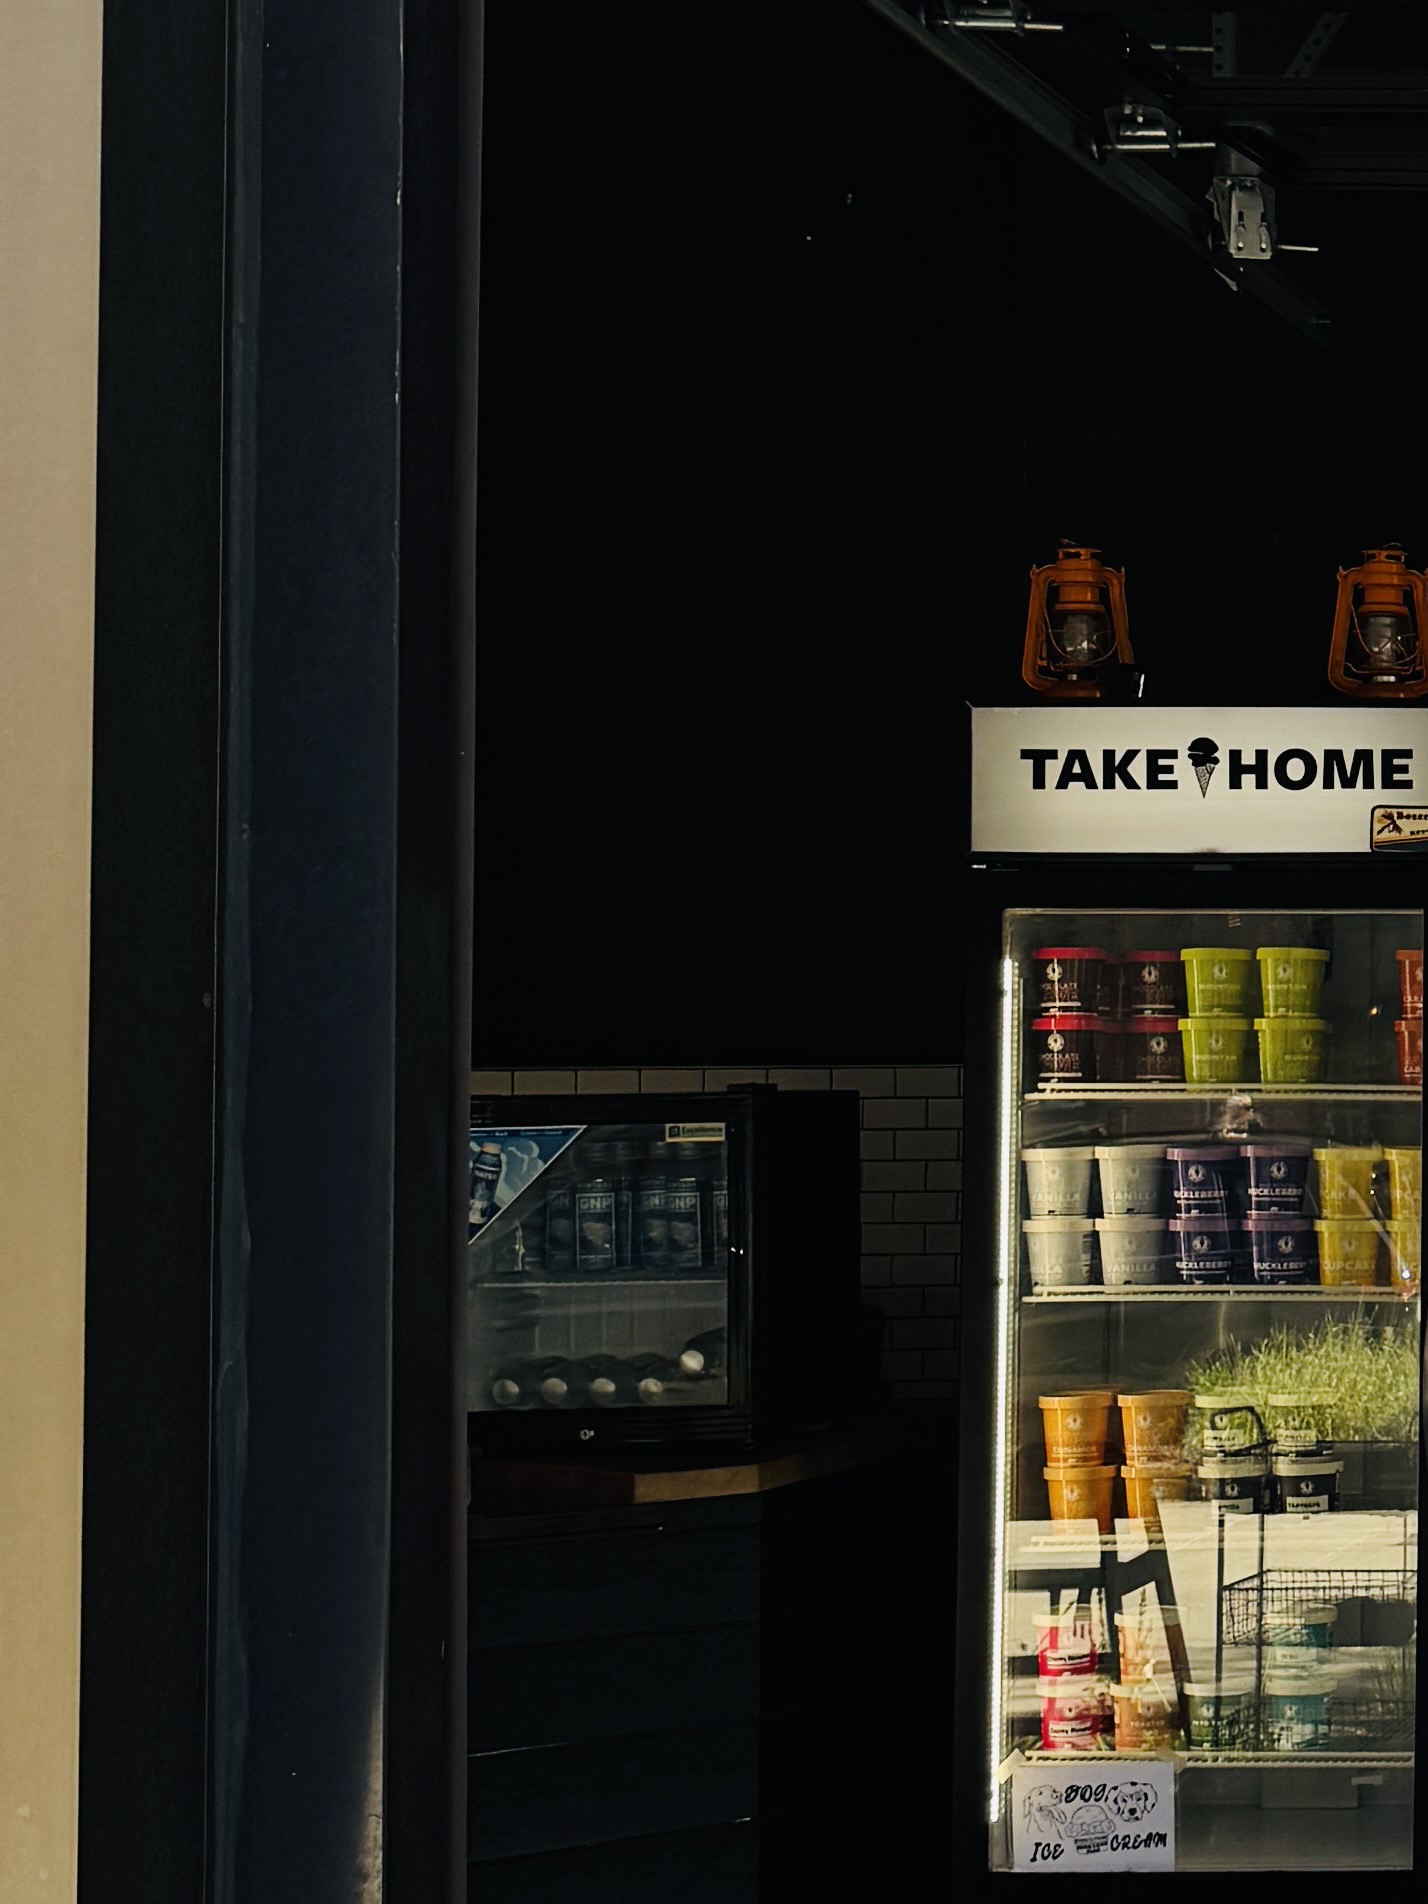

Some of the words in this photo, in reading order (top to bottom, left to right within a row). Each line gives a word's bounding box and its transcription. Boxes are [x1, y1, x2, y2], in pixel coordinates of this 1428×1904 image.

[1020, 748, 1179, 790] TAKE
[1229, 748, 1414, 790] HOME
[580, 1197, 613, 1210] GNP
[1030, 1842, 1065, 1863] ICE
[1110, 1831, 1168, 1852] CREAM
